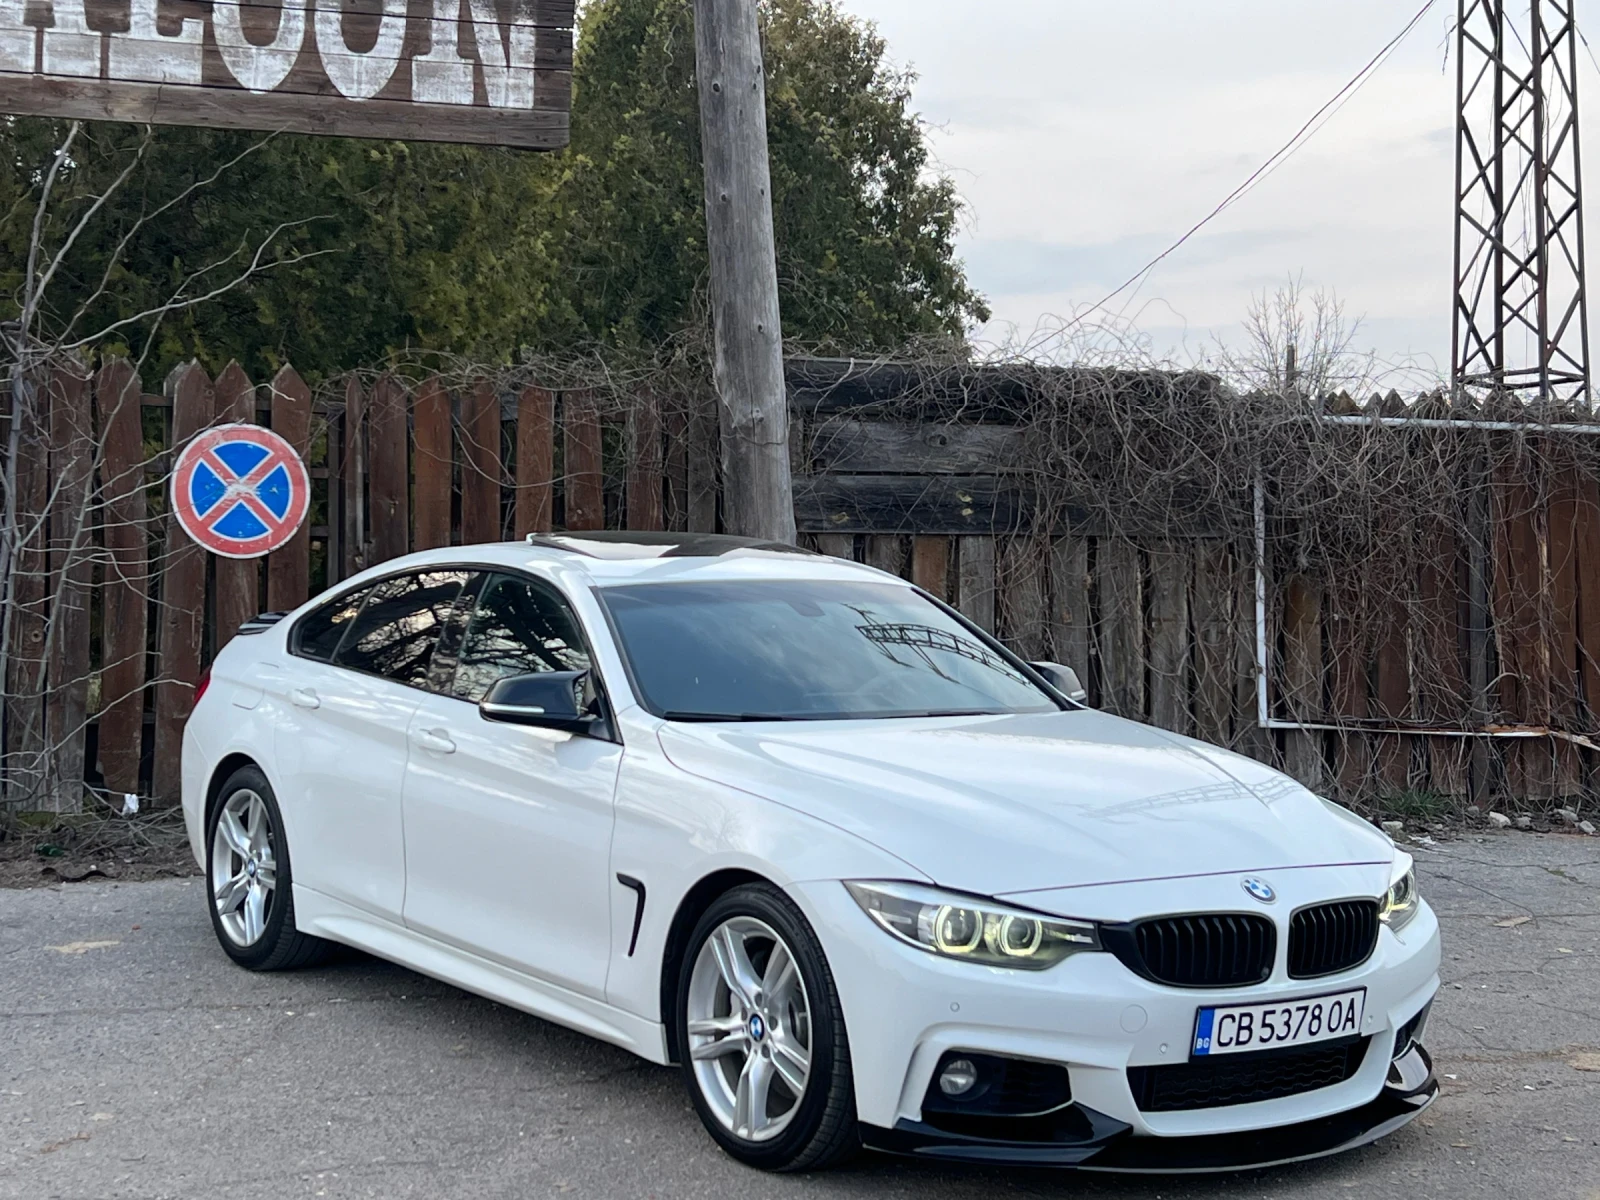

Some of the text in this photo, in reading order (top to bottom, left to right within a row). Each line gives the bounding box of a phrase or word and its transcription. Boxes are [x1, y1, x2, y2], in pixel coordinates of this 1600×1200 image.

[1217, 1012, 1254, 1047] CB
[1259, 1003, 1323, 1043] 5378
[1196, 1037, 1210, 1049] BG
